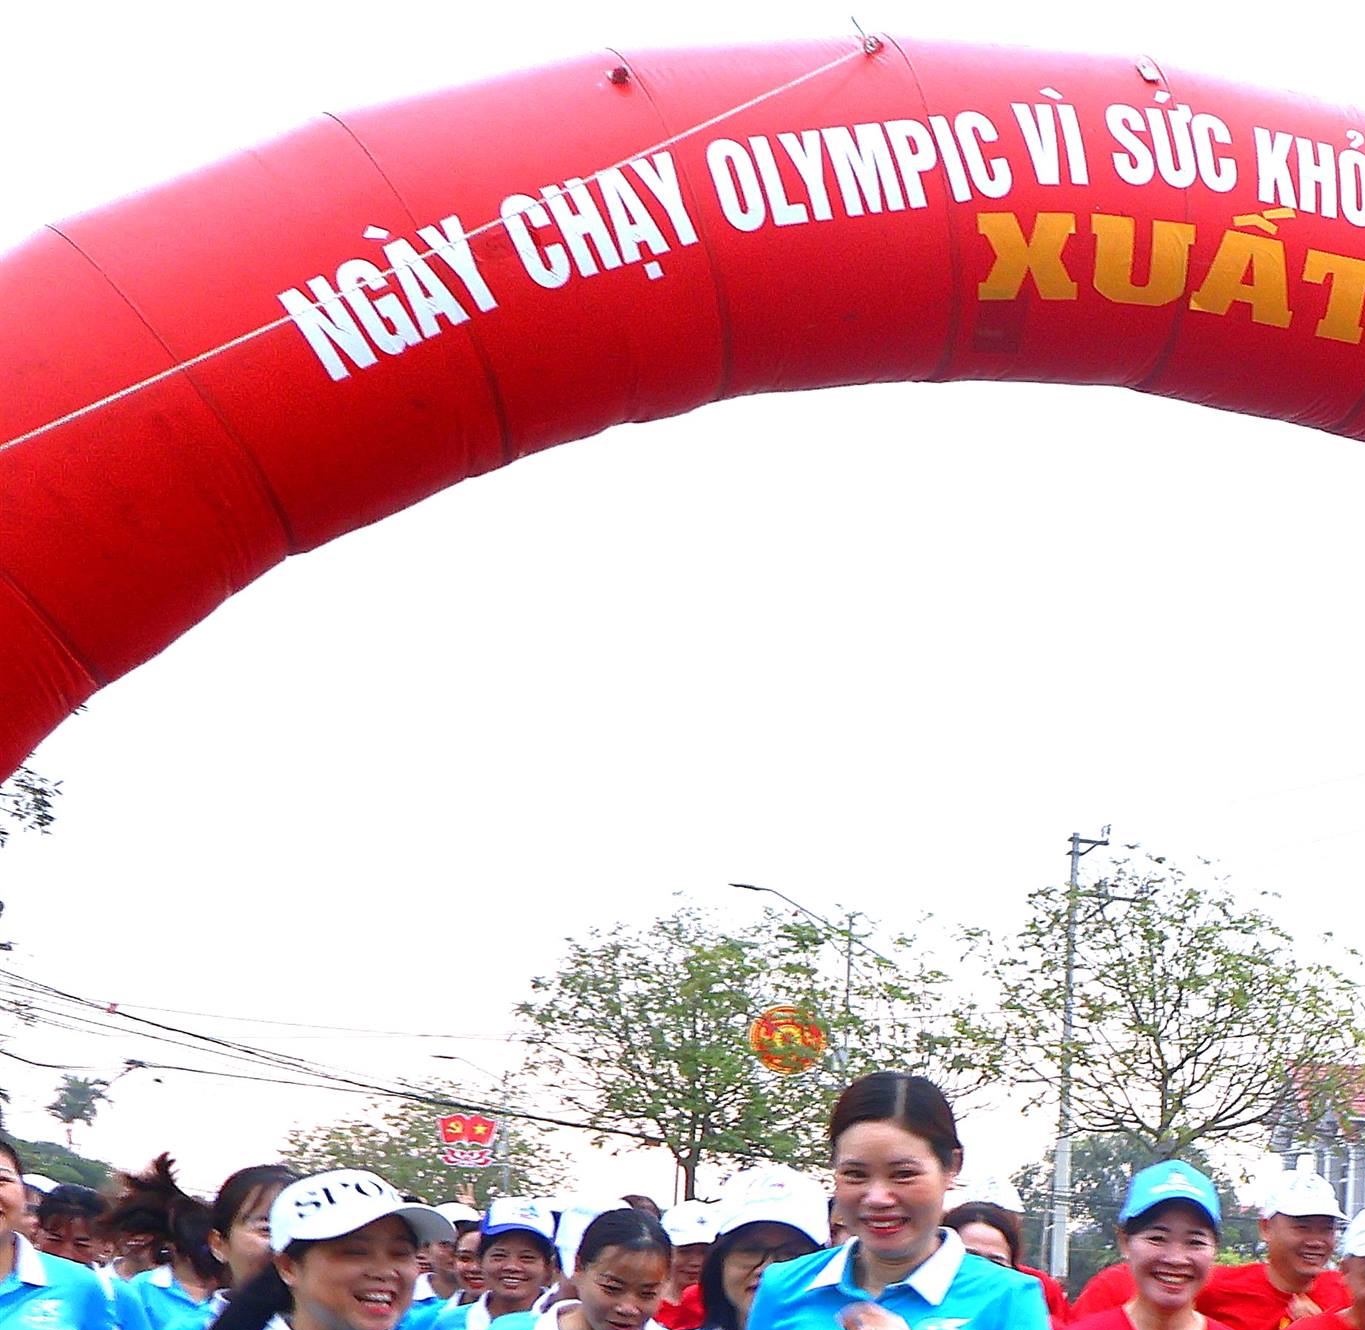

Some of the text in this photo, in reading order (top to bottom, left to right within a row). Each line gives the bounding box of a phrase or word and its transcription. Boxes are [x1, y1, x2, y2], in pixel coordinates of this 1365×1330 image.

[276, 214, 498, 382] NGÀY
[499, 150, 700, 288] CHẠY
[705, 110, 1014, 232] OLYMPIC
[1010, 87, 1090, 187] VÌ
[1105, 89, 1237, 194] SỨC
